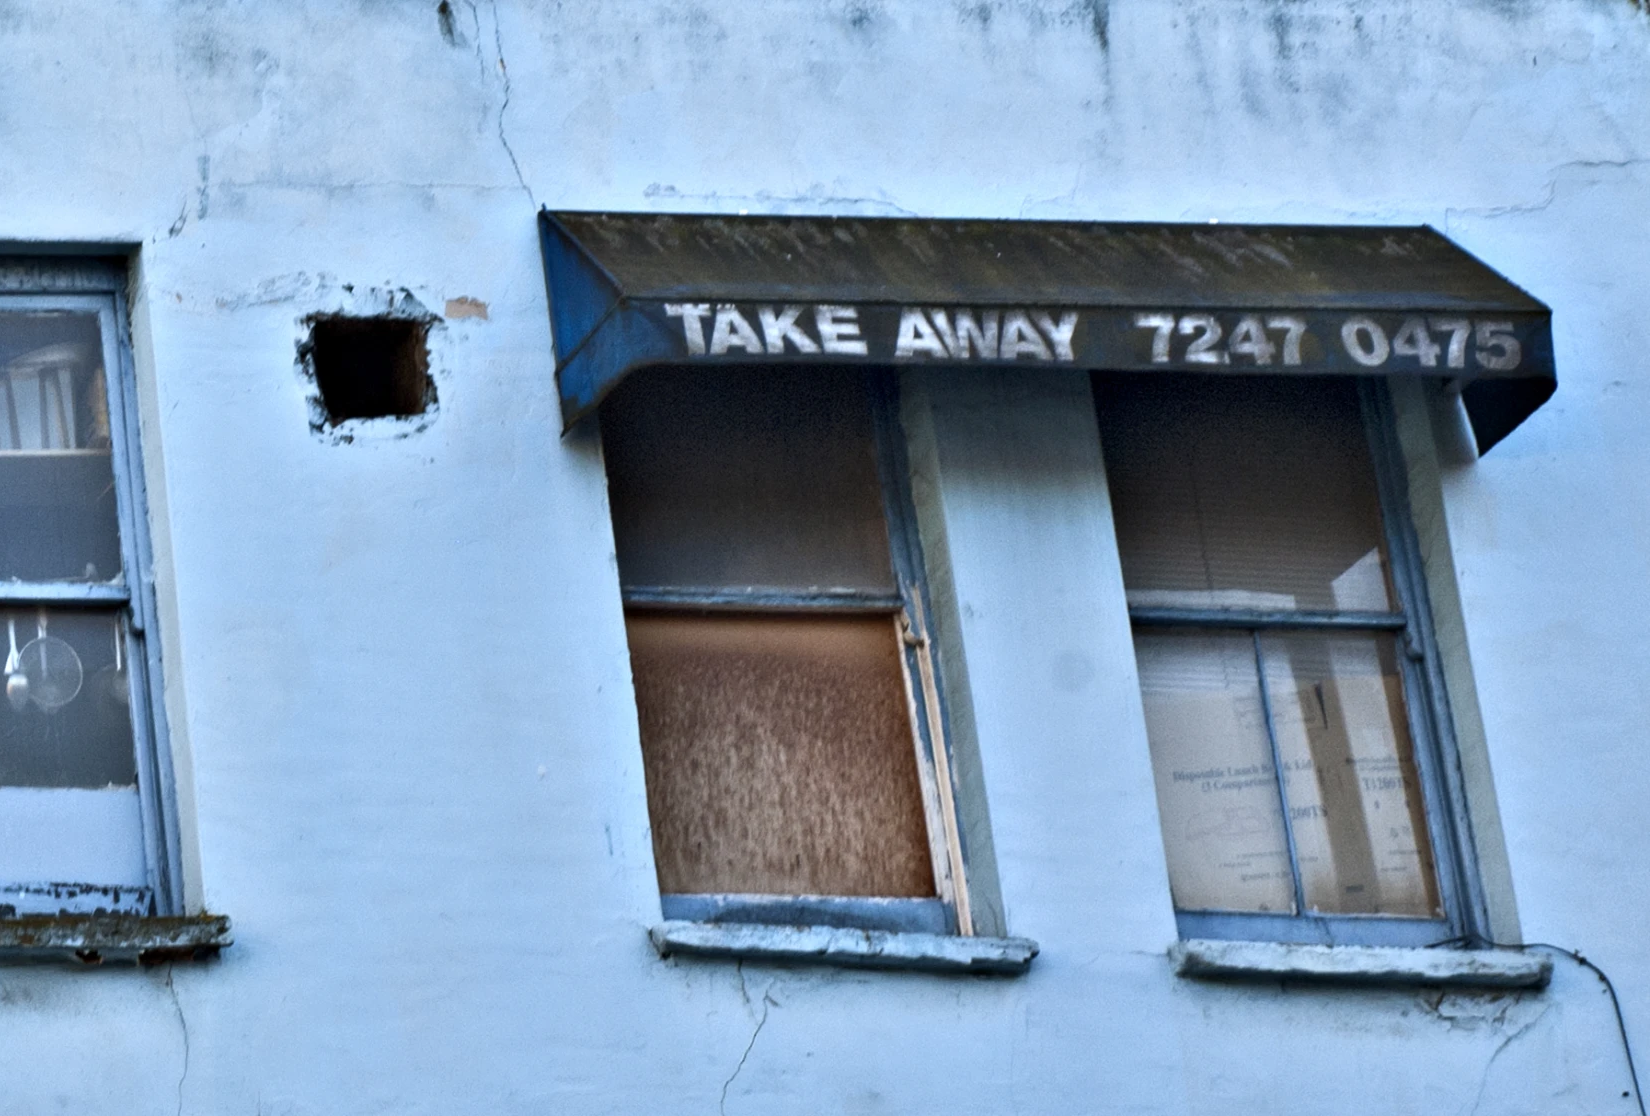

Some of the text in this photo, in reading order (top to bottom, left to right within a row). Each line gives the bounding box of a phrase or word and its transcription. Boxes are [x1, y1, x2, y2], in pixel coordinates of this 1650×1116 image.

[664, 302, 1522, 371] TAKE AWAY 7247 0475
